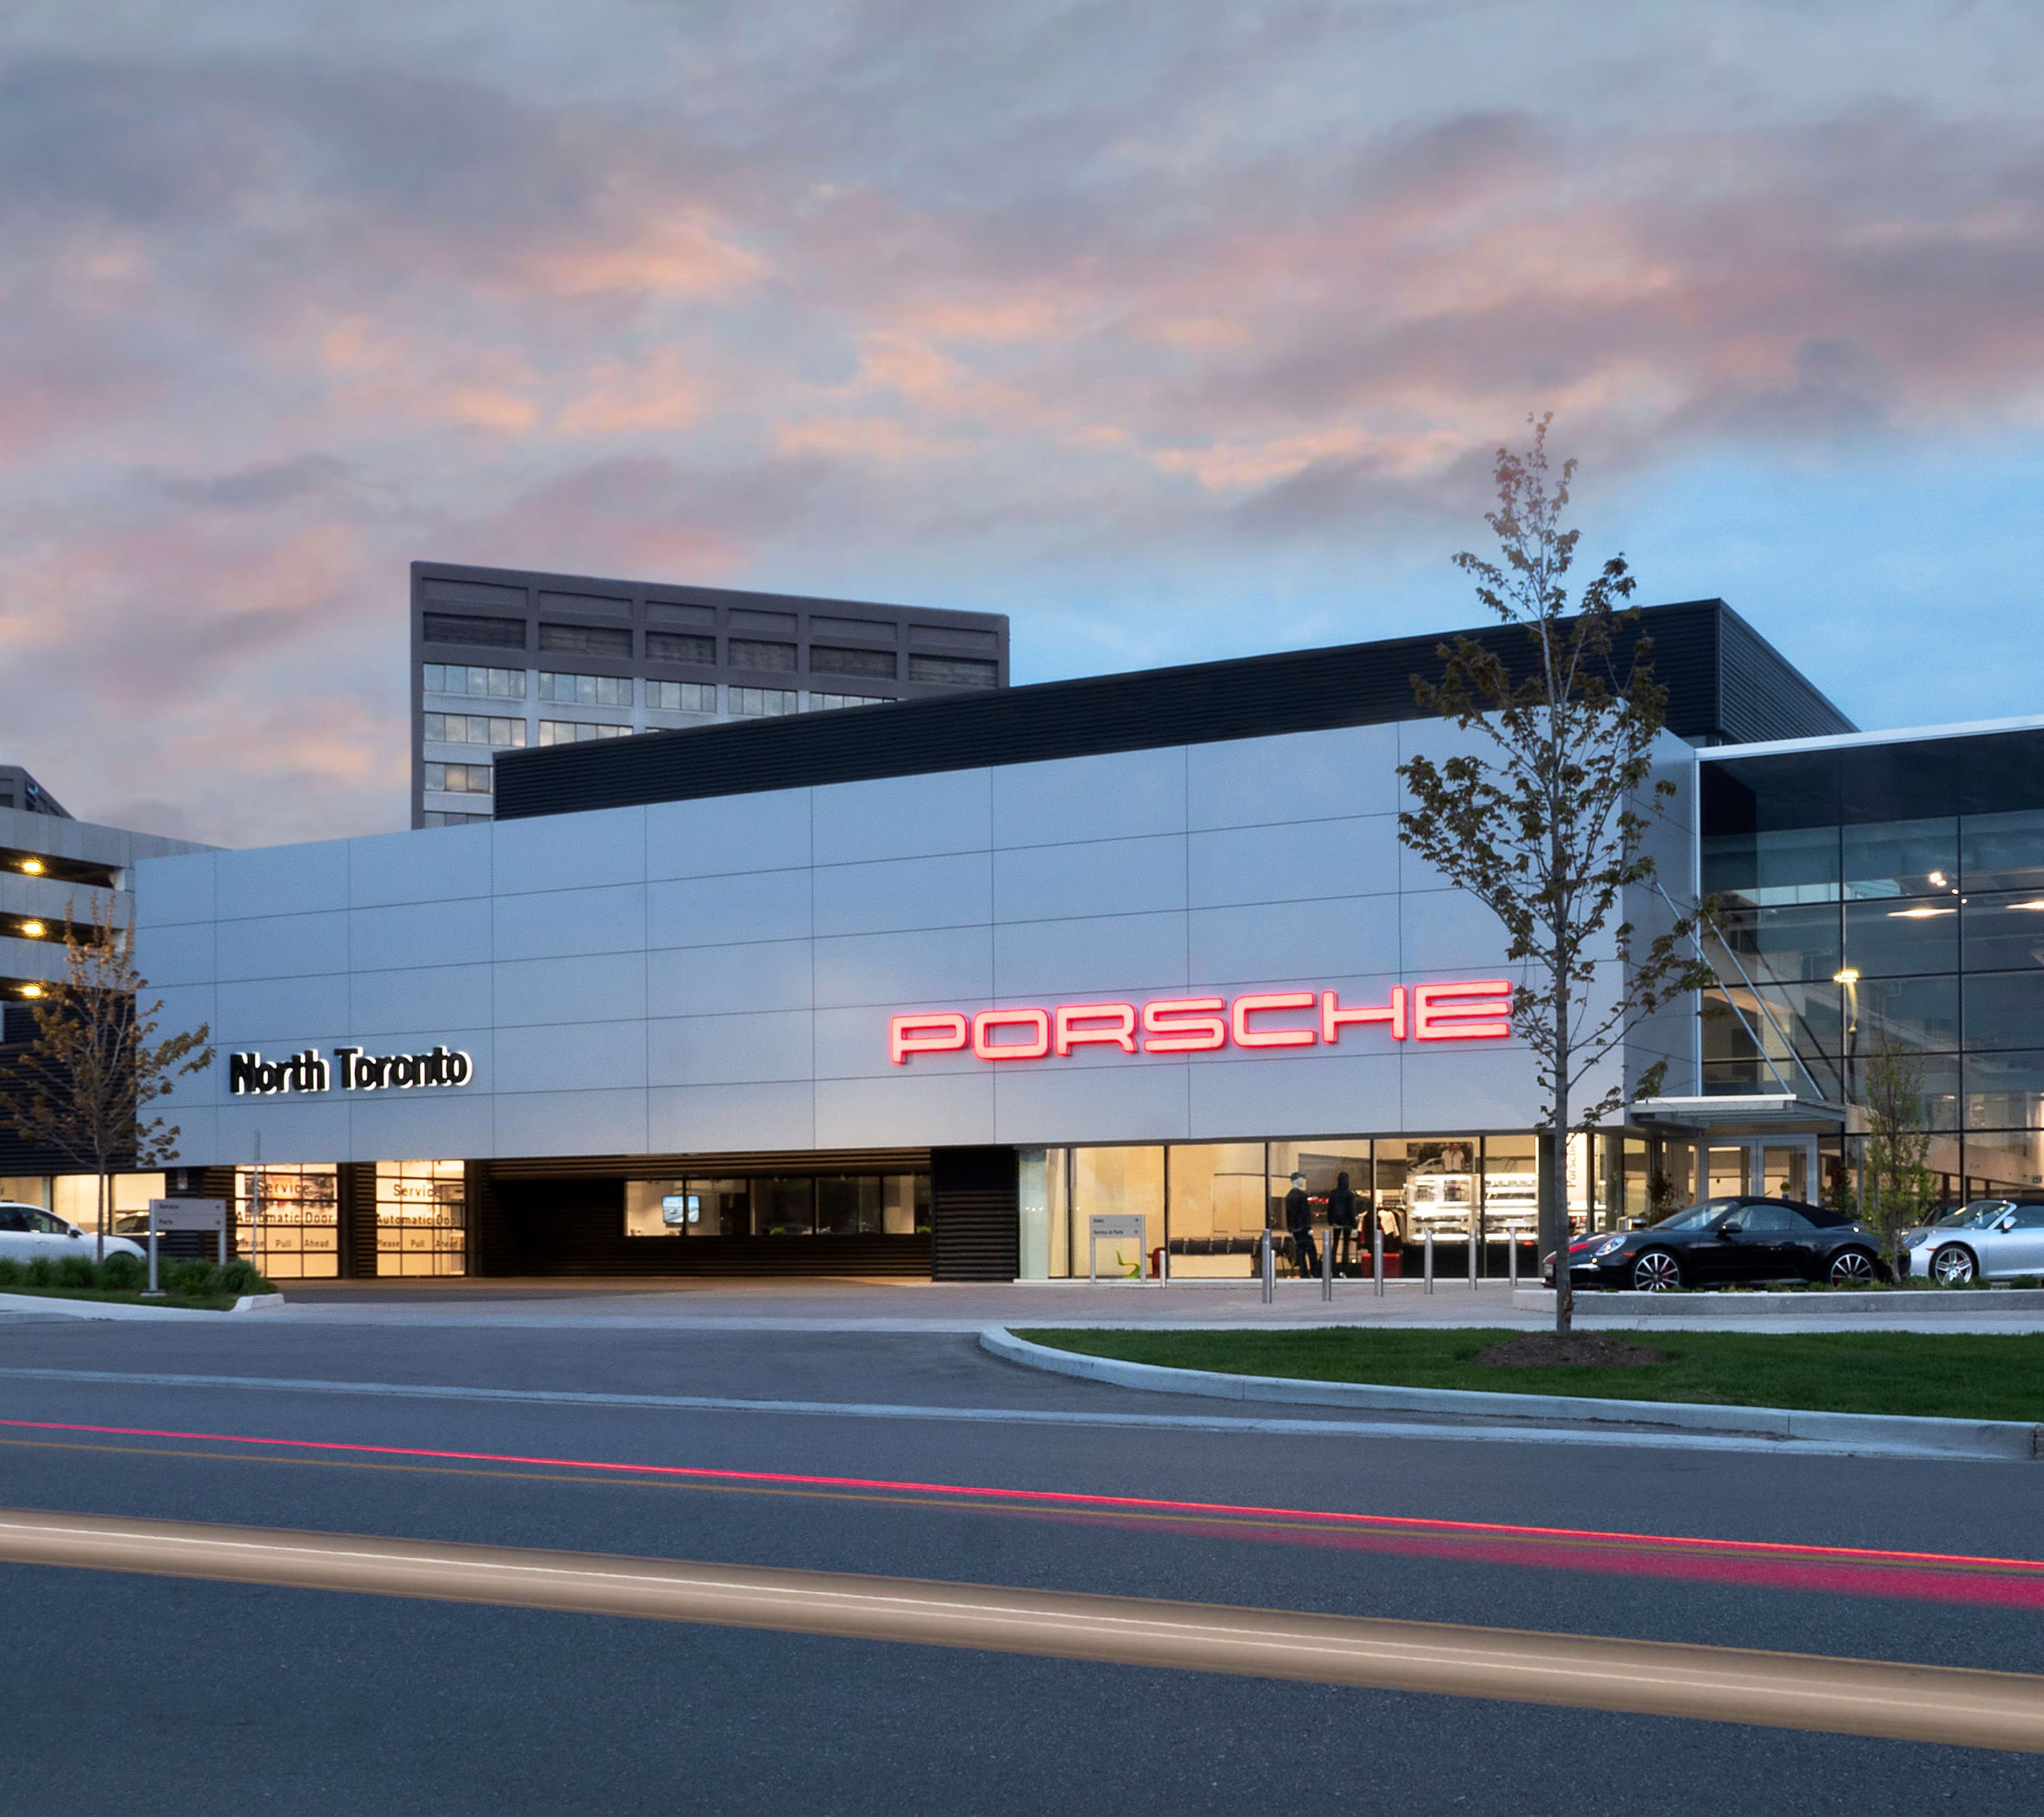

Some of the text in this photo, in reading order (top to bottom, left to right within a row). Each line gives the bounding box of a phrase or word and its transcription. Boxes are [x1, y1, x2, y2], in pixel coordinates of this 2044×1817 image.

[891, 980, 1511, 1065] PORSCHE
[230, 1046, 472, 1095] North Toronto
[258, 1180, 309, 1193] Service
[393, 1184, 442, 1197] Service
[236, 1211, 333, 1224] Auomatic Door
[377, 1213, 461, 1225] Automatic Door
[275, 1239, 292, 1248] Pull
[304, 1239, 329, 1248] Ahead
[410, 1239, 425, 1248] Pull
